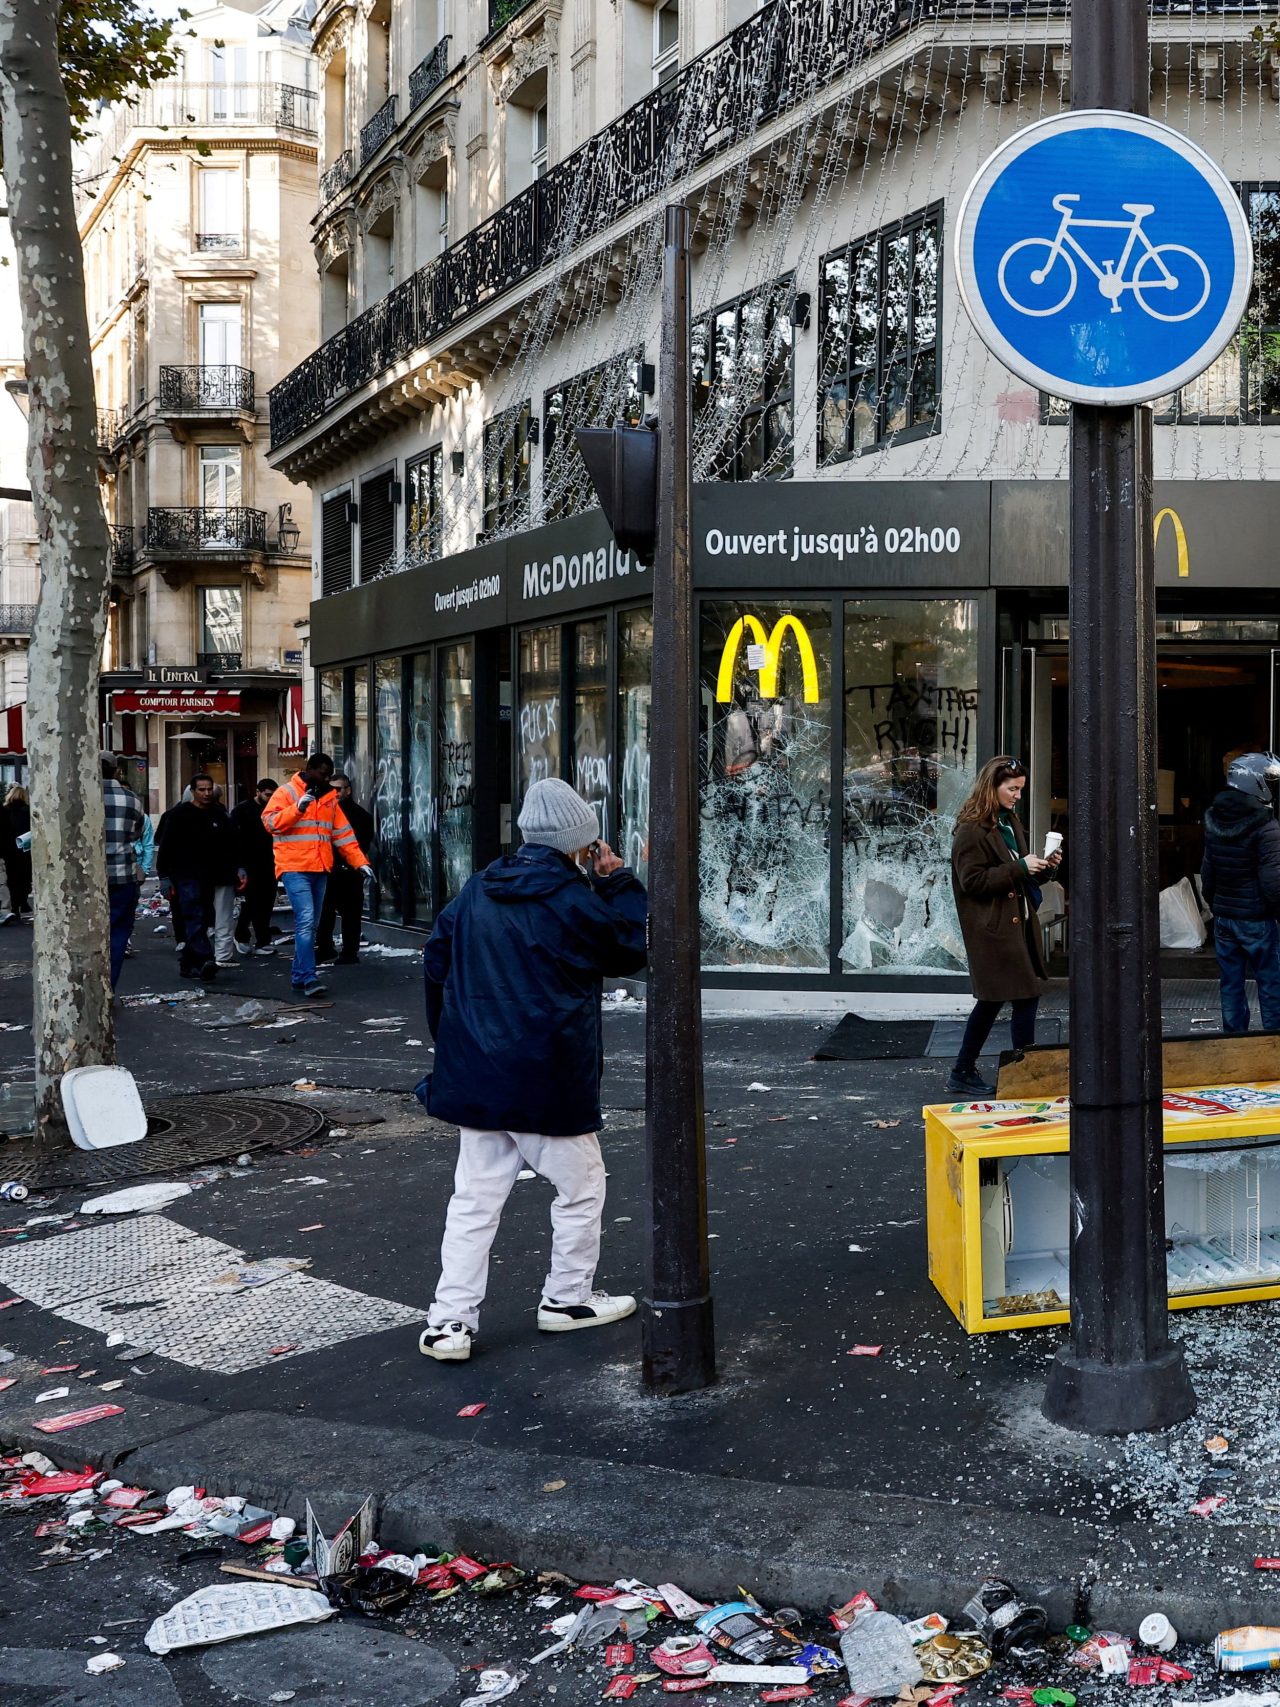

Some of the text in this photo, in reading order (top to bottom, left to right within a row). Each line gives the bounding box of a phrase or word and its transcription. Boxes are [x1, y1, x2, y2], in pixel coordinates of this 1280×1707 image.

[705, 524, 961, 561] Ouvert jusqu'à 02h00
[434, 574, 500, 613] Ouvert jusqu'à 02h00
[140, 697, 215, 707] COMPTOIR PARISIEN
[845, 683, 981, 713] TAX THE
[520, 697, 557, 754] FUCK
